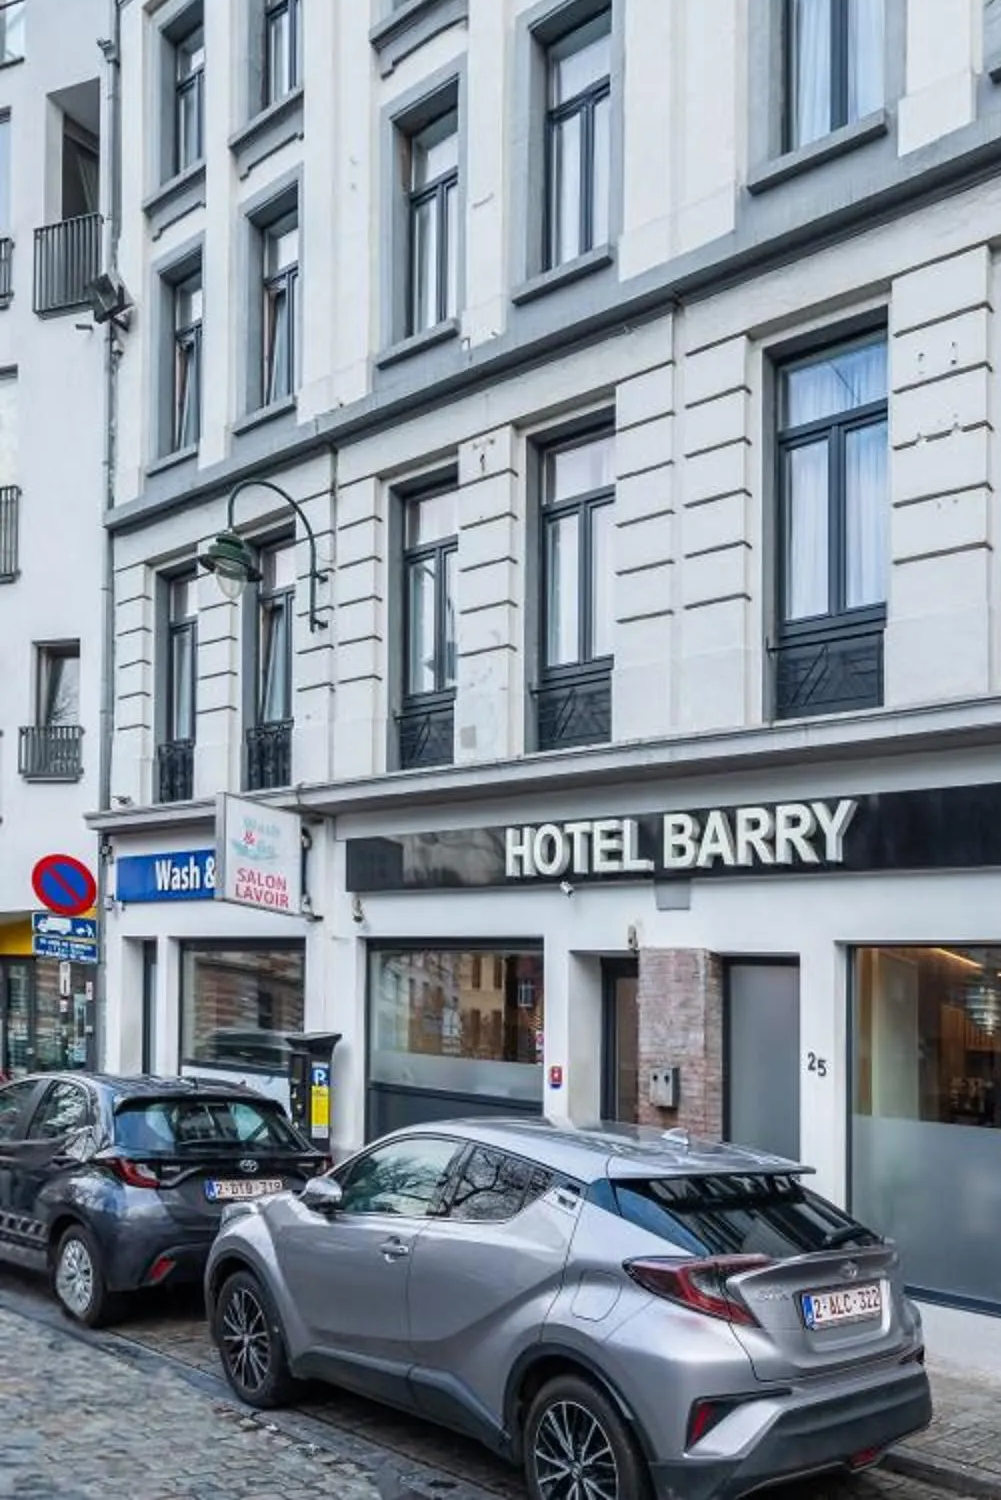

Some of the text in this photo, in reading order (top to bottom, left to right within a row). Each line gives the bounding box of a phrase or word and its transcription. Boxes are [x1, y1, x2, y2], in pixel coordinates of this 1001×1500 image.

[505, 800, 858, 877] HOTEL BARRY
[155, 856, 215, 891] Wash &
[237, 867, 287, 891] SALON
[235, 885, 289, 908] LAVOIR
[807, 1051, 827, 1077] 25
[313, 1068, 327, 1087] P
